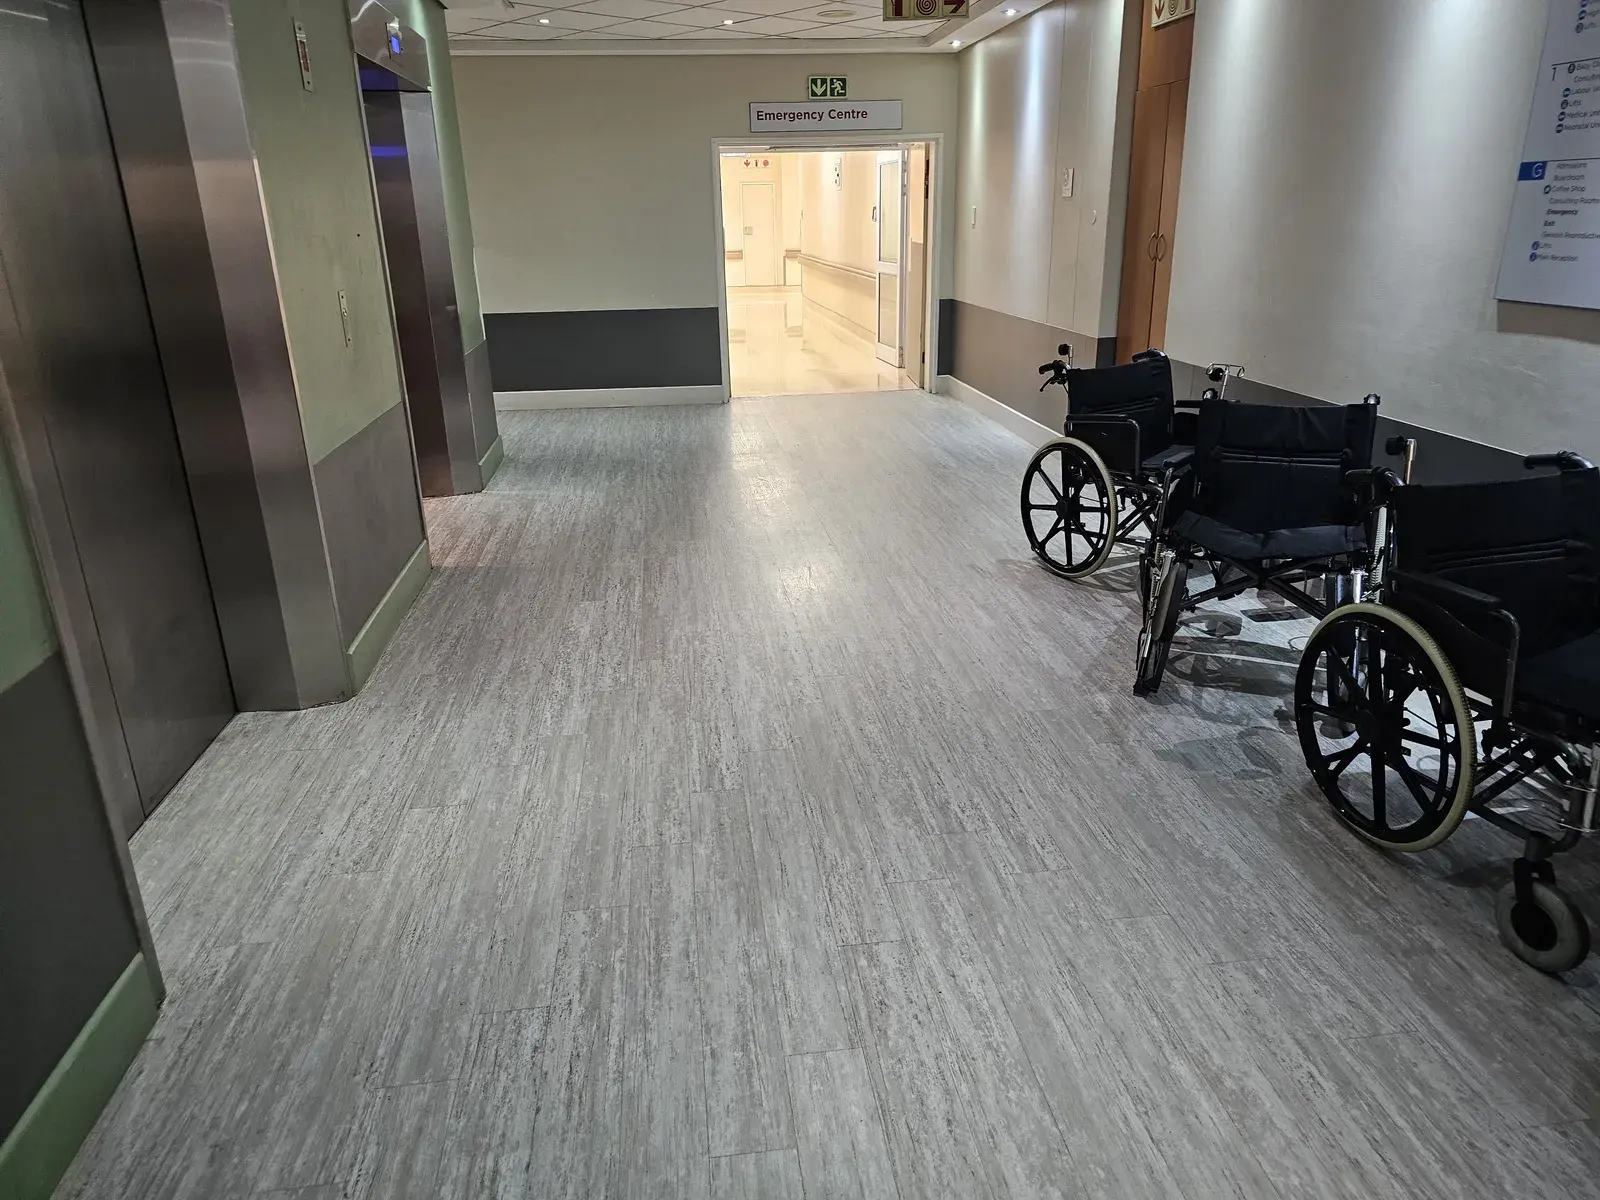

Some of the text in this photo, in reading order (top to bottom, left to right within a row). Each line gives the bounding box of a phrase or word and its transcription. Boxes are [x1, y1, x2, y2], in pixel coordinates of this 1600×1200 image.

[756, 109, 868, 122] Emergency Centre
[1533, 163, 1544, 178] G
[1553, 174, 1585, 182] Boardroom
[1551, 185, 1587, 193] Coffee Shop
[1549, 197, 1578, 205] Consulting
[1546, 208, 1579, 216] Emergency
